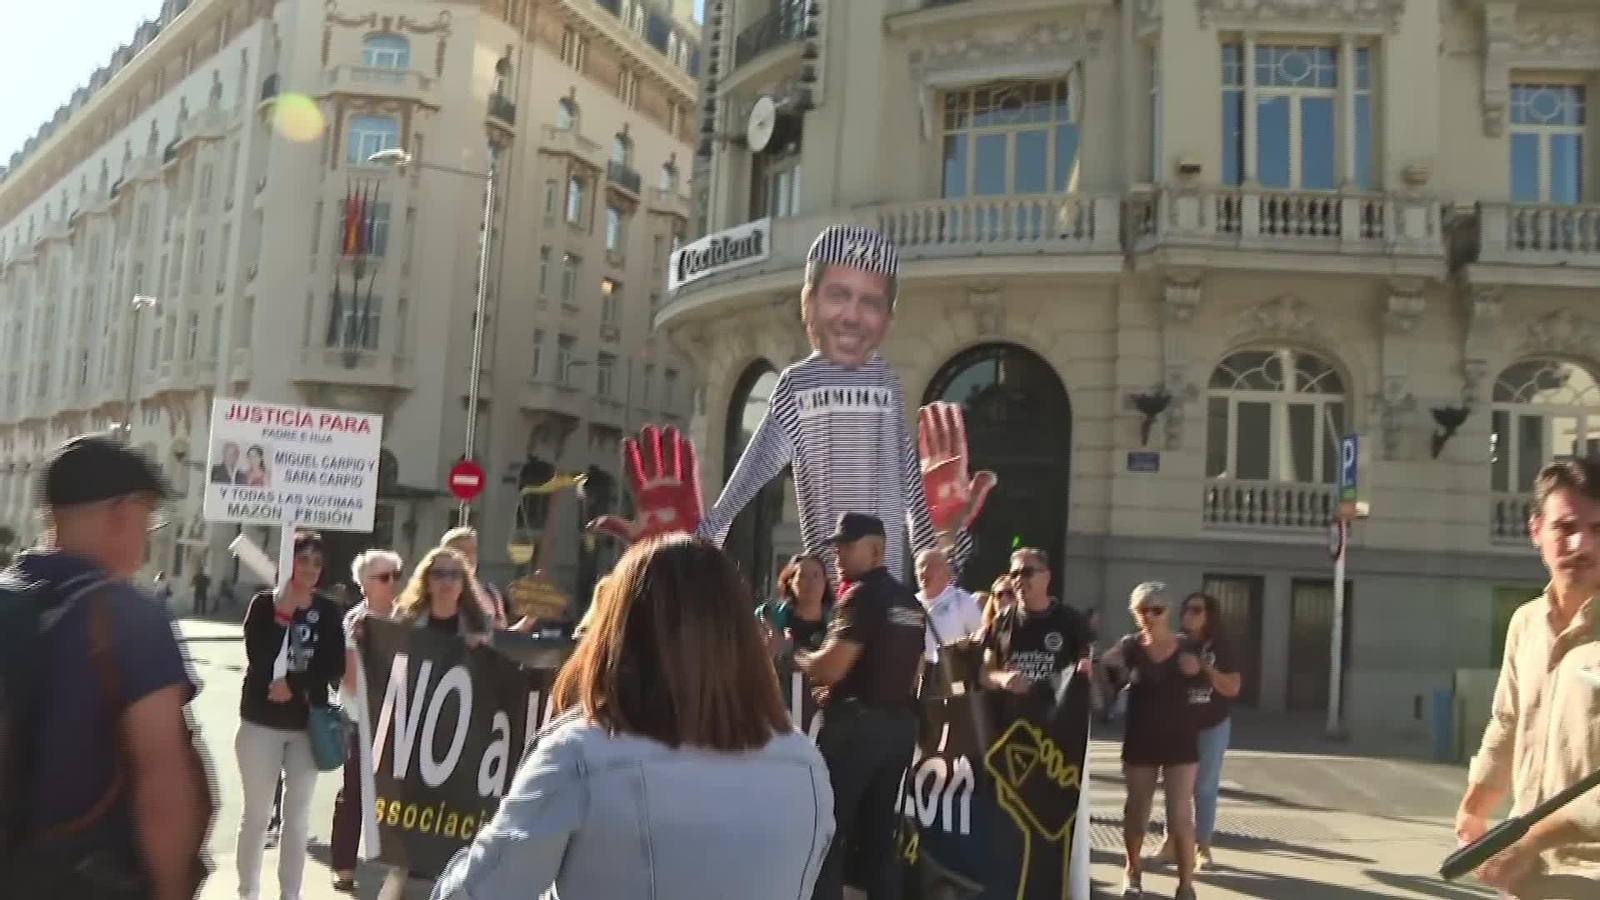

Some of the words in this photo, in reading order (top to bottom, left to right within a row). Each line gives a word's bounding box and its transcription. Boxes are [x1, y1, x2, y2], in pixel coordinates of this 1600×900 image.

[678, 228, 763, 281] Occident
[319, 413, 371, 434] PARA
[262, 428, 297, 441] PADRE
[300, 432, 307, 442] E
[309, 433, 334, 445] HIJA
[275, 450, 318, 468] MIGUEL
[320, 455, 365, 471] CARPIO
[367, 460, 375, 471] Y
[284, 468, 317, 484] SARA
[319, 471, 363, 488] CARPIO
[220, 486, 228, 499] Y
[232, 487, 275, 502] TODAS
[278, 491, 302, 505] LAS
[372, 653, 473, 787] NO
[477, 709, 511, 797] a
